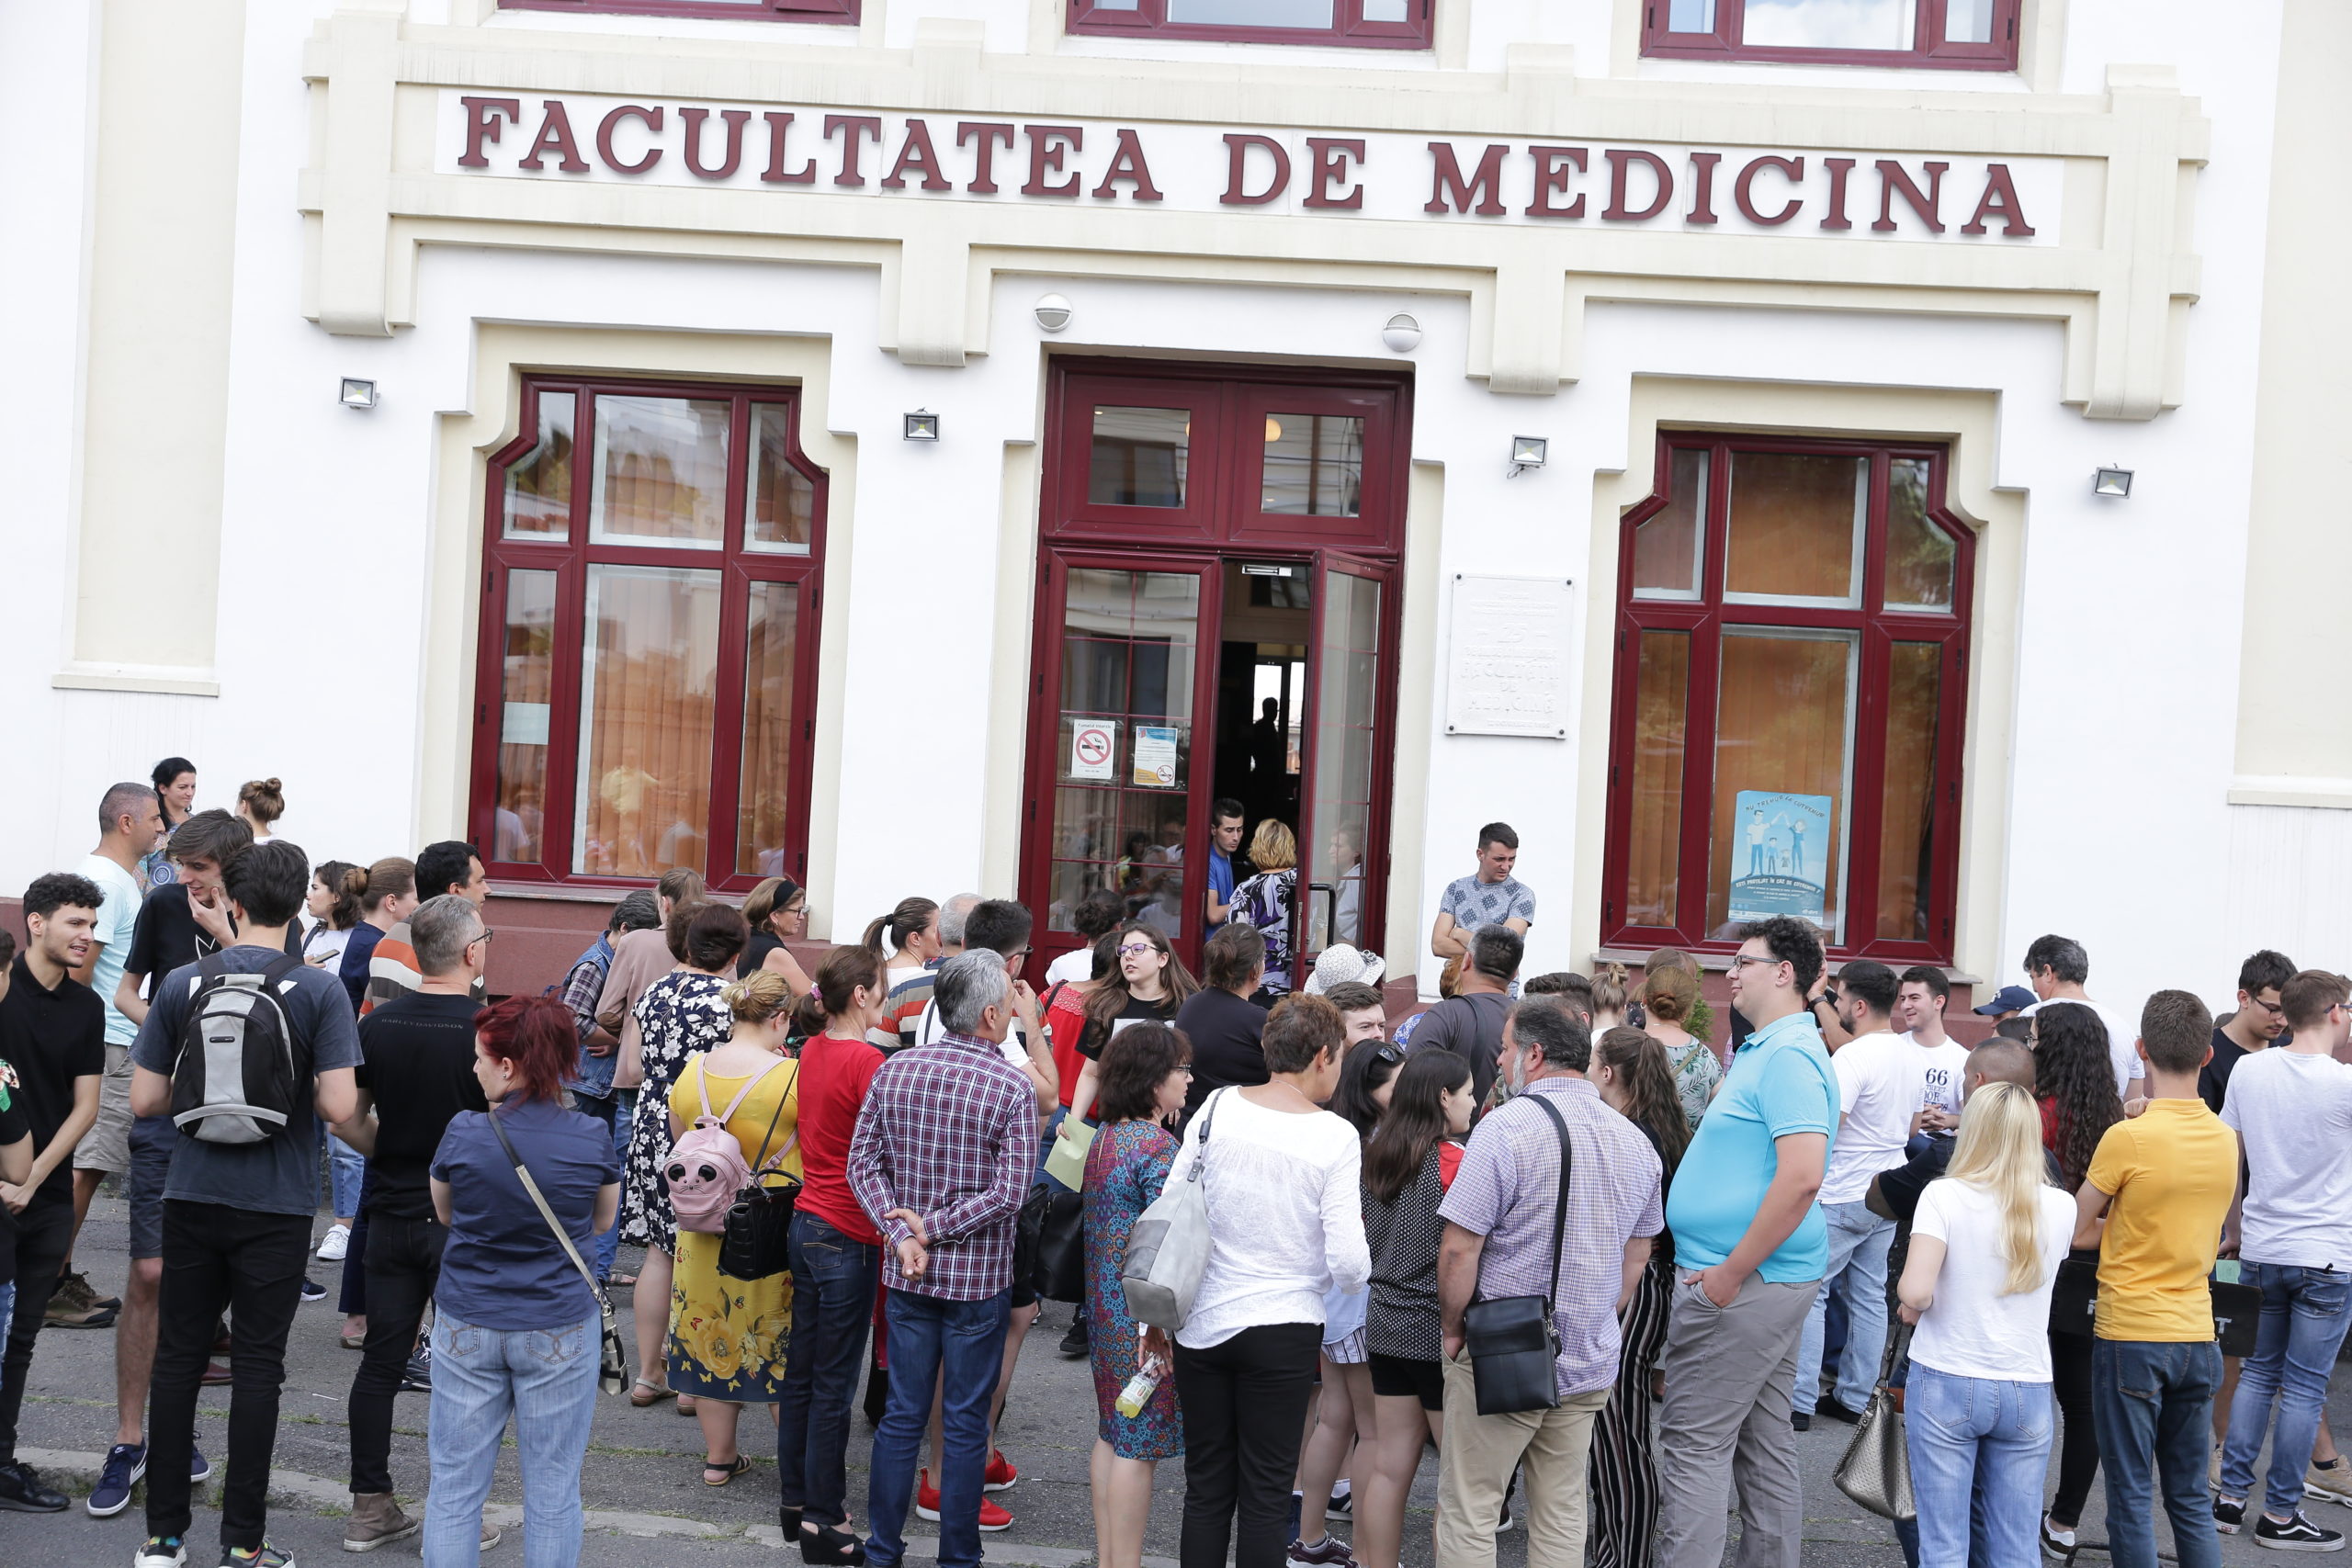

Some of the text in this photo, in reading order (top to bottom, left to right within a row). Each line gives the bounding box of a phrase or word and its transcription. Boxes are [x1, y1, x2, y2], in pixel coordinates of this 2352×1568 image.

[458, 95, 2035, 236] FACULTATEA DE MEDICINA
[1926, 1067, 1948, 1087] 66
